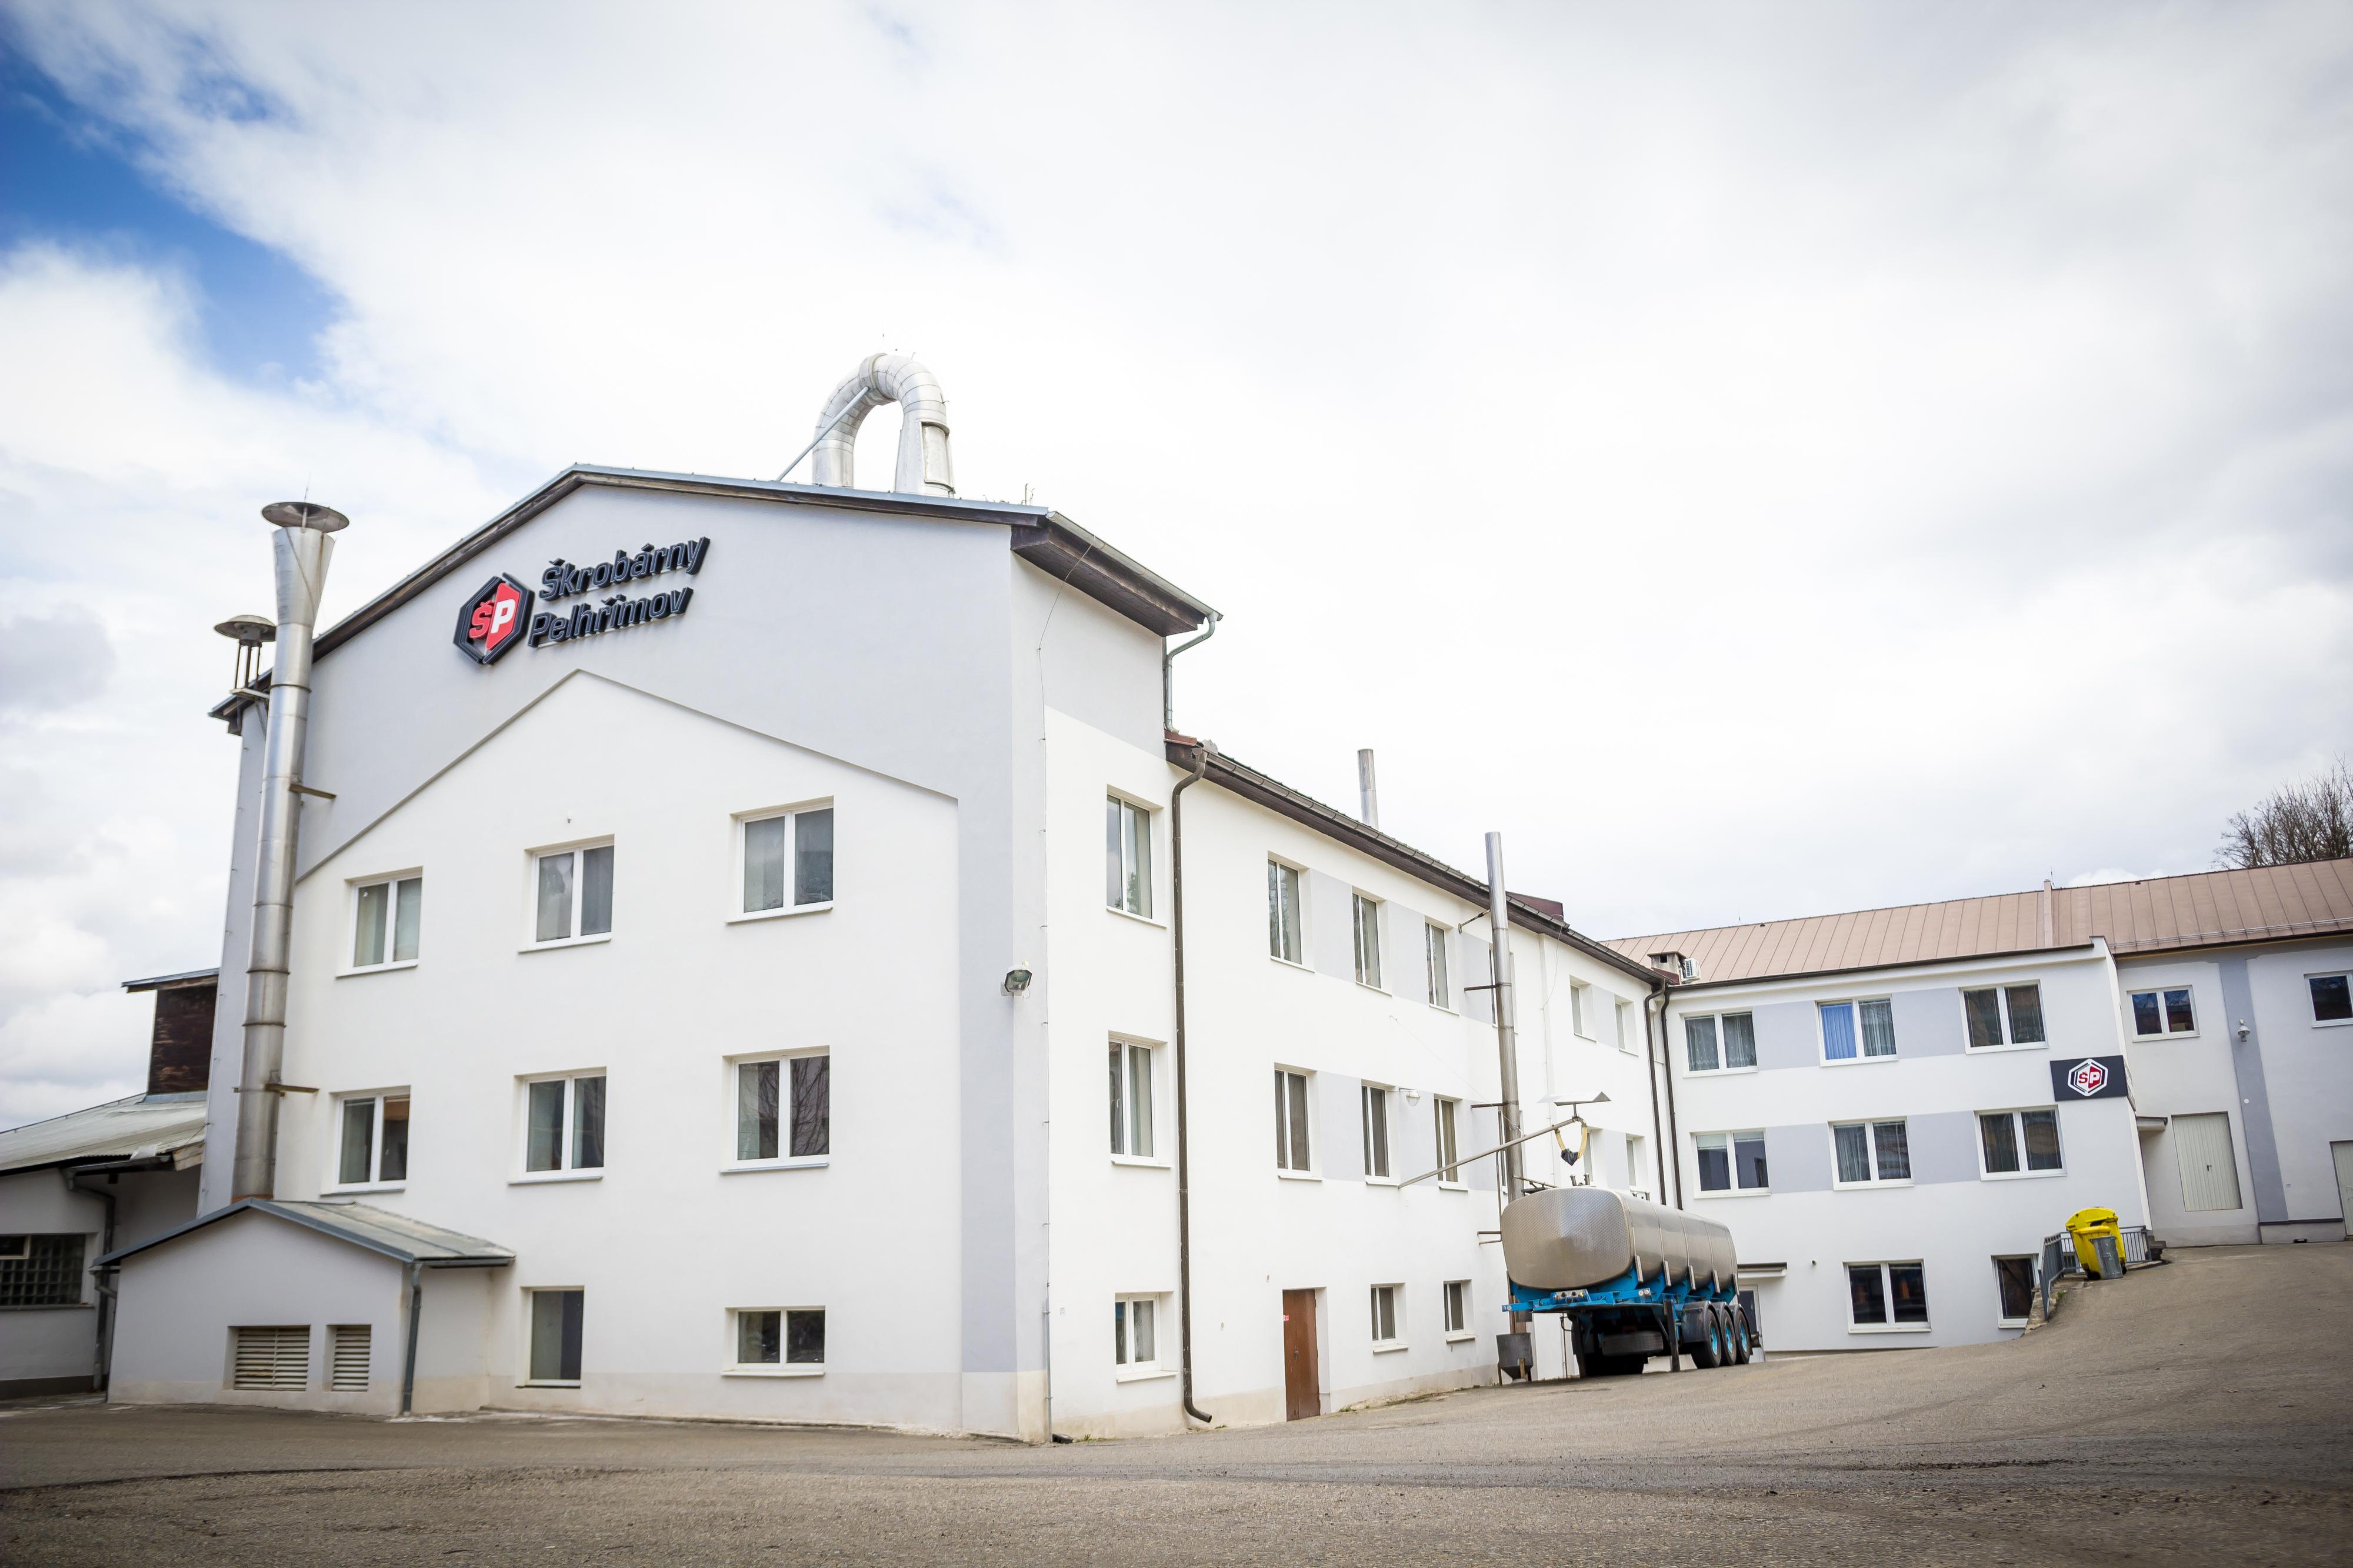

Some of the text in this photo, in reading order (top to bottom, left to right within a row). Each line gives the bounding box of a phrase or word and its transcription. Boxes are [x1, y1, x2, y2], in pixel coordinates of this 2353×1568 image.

[539, 536, 711, 601] Škrobárny
[469, 599, 516, 639] ŠP
[527, 587, 694, 648] Pelhřimov
[2078, 1071, 2100, 1084] ŠP
